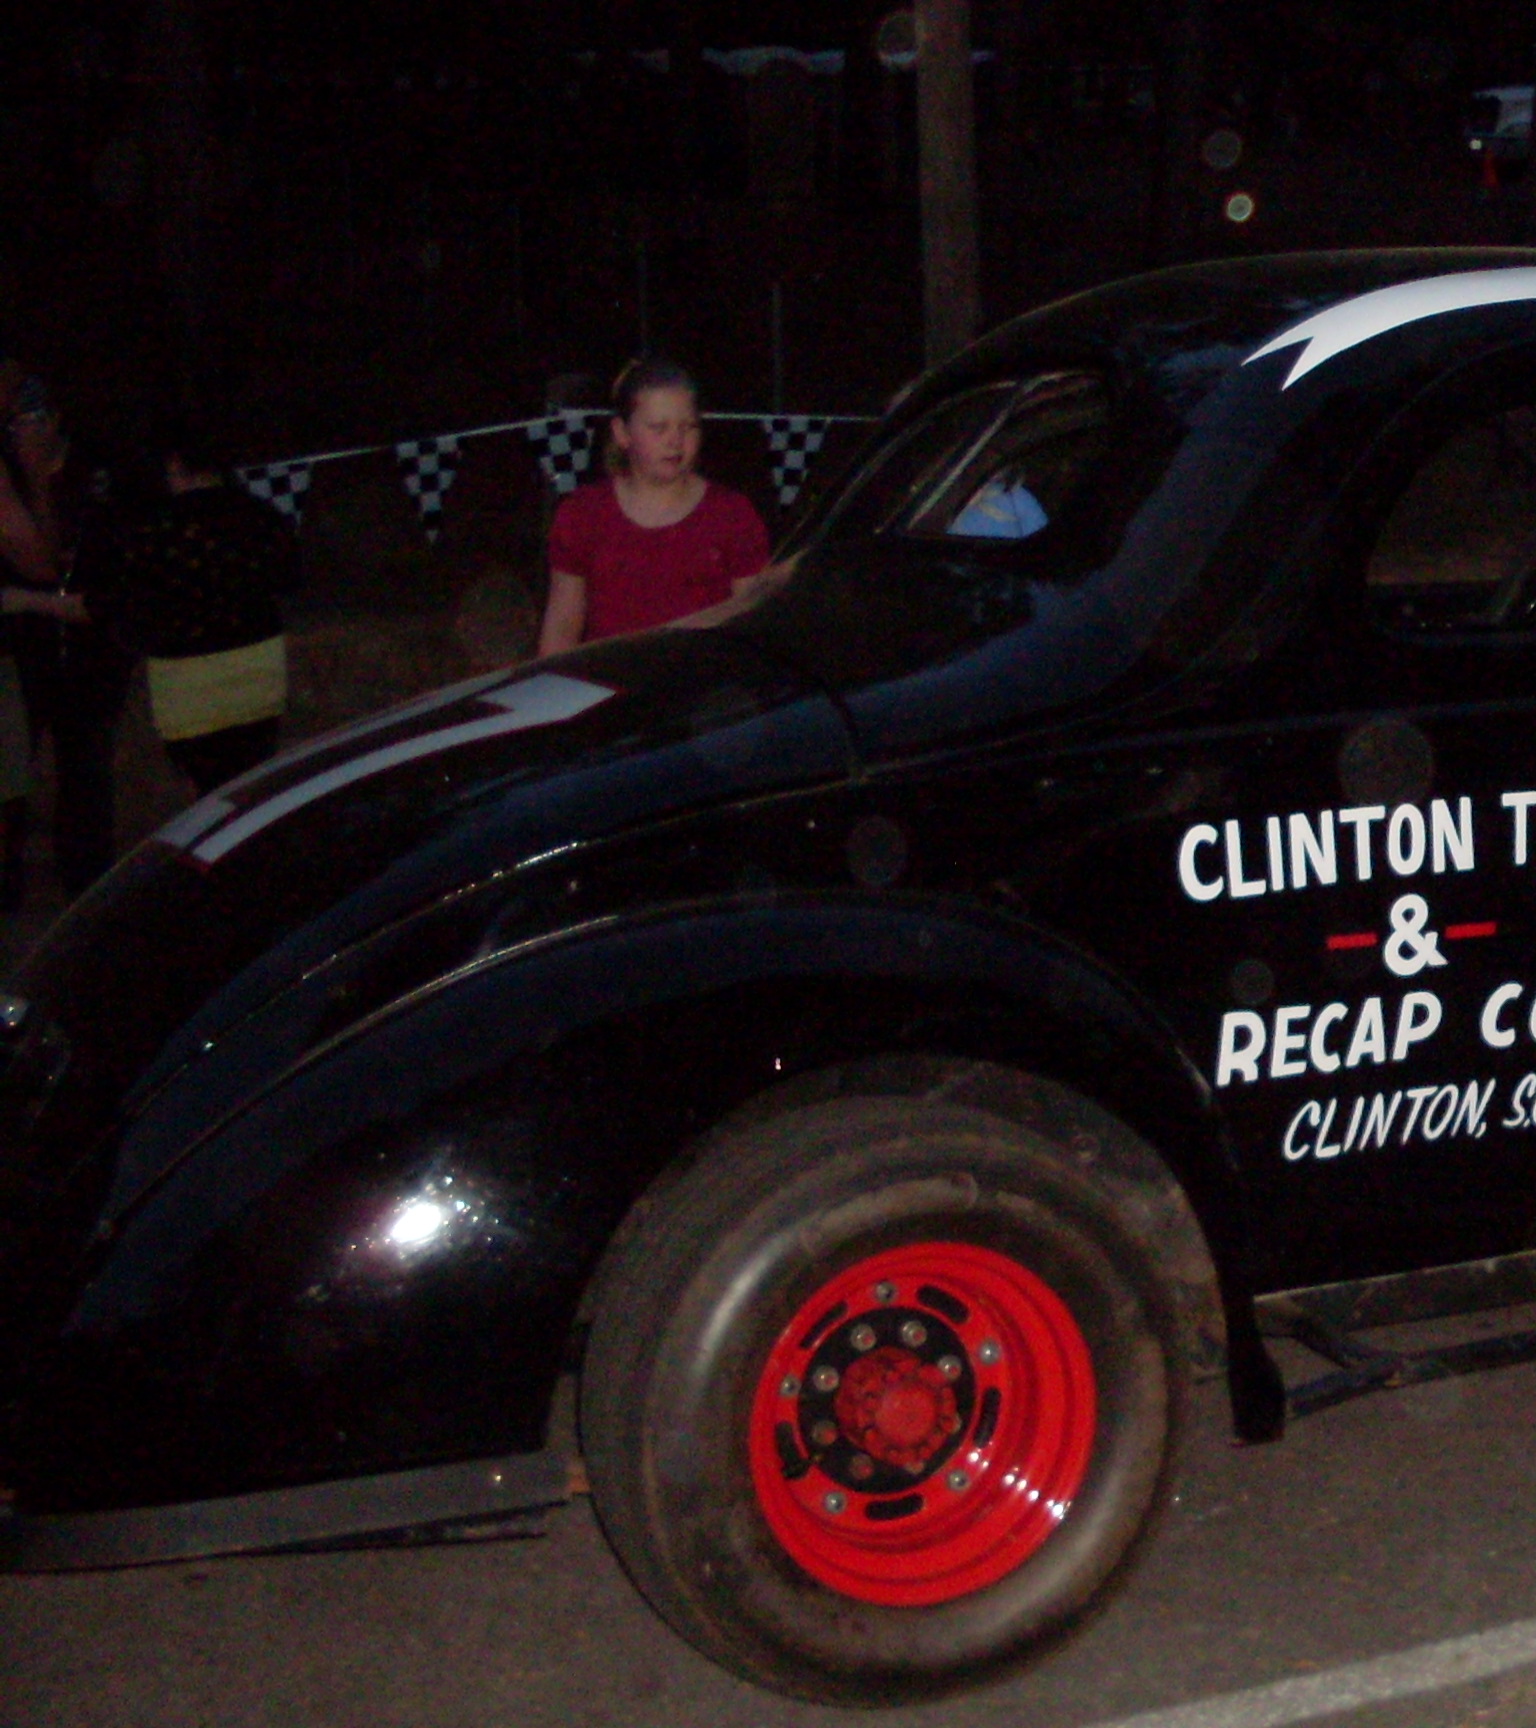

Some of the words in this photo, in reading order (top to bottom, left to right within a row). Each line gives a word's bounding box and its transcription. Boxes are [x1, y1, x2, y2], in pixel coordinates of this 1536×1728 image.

[1177, 795, 1475, 903] CLINTON
[1382, 893, 1449, 977] &
[1215, 990, 1443, 1088] RECAP
[1282, 1077, 1497, 1161] CLINTON,
